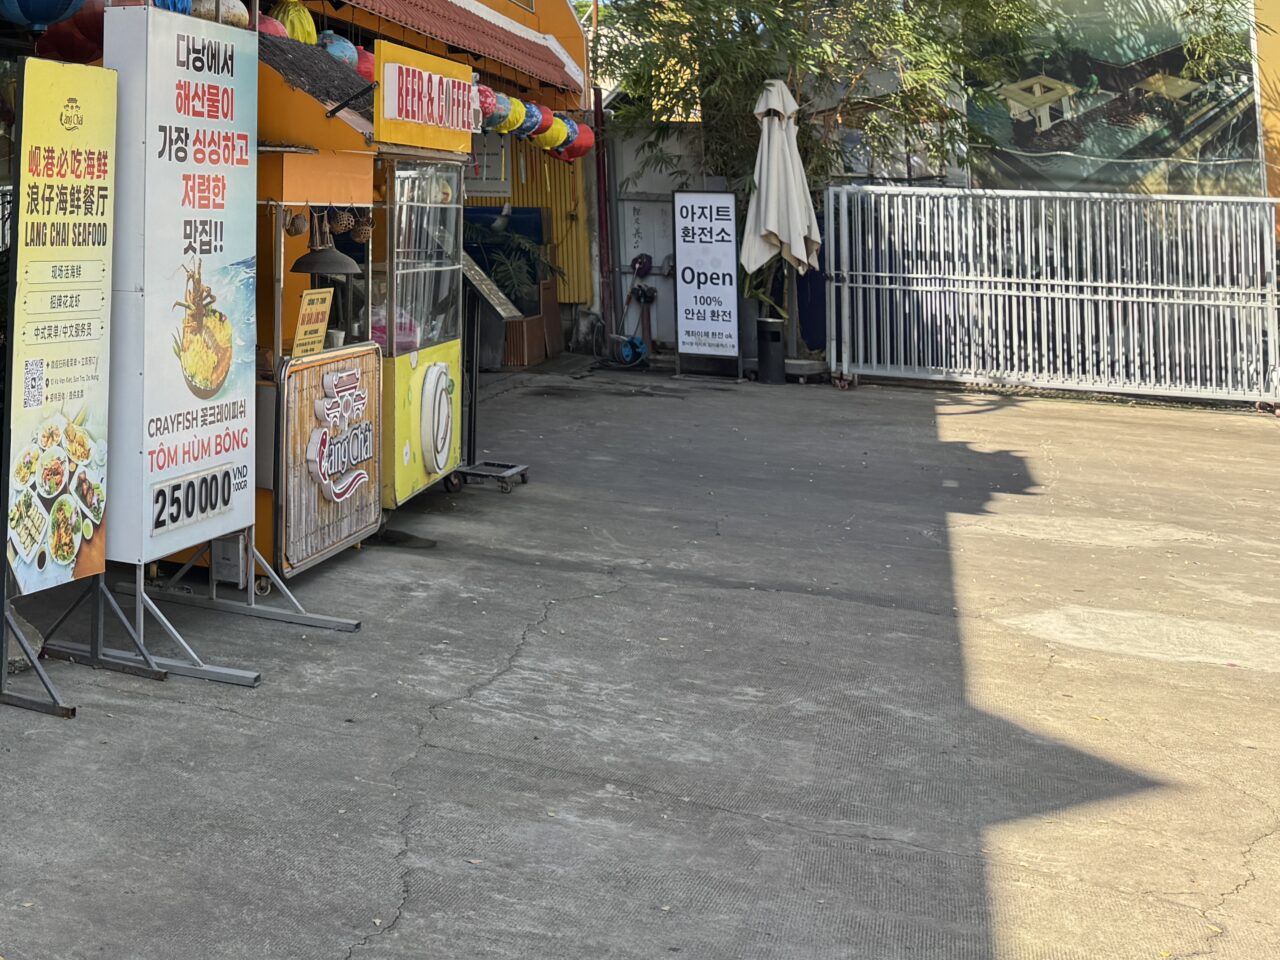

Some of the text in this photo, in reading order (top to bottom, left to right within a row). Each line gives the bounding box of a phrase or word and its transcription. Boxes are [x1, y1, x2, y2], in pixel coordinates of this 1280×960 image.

[176, 33, 234, 77] 다낭에서
[175, 79, 234, 121] 해산물이
[398, 65, 472, 130] BEER & COFFEE
[28, 145, 108, 180] 岘港必吃海鲜
[158, 125, 249, 166] 가장 싱싱하고
[26, 182, 108, 217] 浪仔海鲜餐厅
[181, 173, 226, 210] 저렴한
[680, 204, 732, 223] 아지트
[24, 221, 108, 247] LANG CHAI SEAFOOD
[183, 219, 224, 255] 맛집!!
[680, 226, 732, 244] 환전소
[681, 266, 733, 289] Open
[684, 308, 732, 322] 안심 환전
[692, 295, 723, 307] 100%
[148, 399, 246, 438] CRAYFISH 꽃크레이피쉬
[148, 426, 249, 473] TÔM HÙM BÔNG
[319, 424, 373, 483] Làng Chài
[154, 464, 248, 529] 250000 VND
